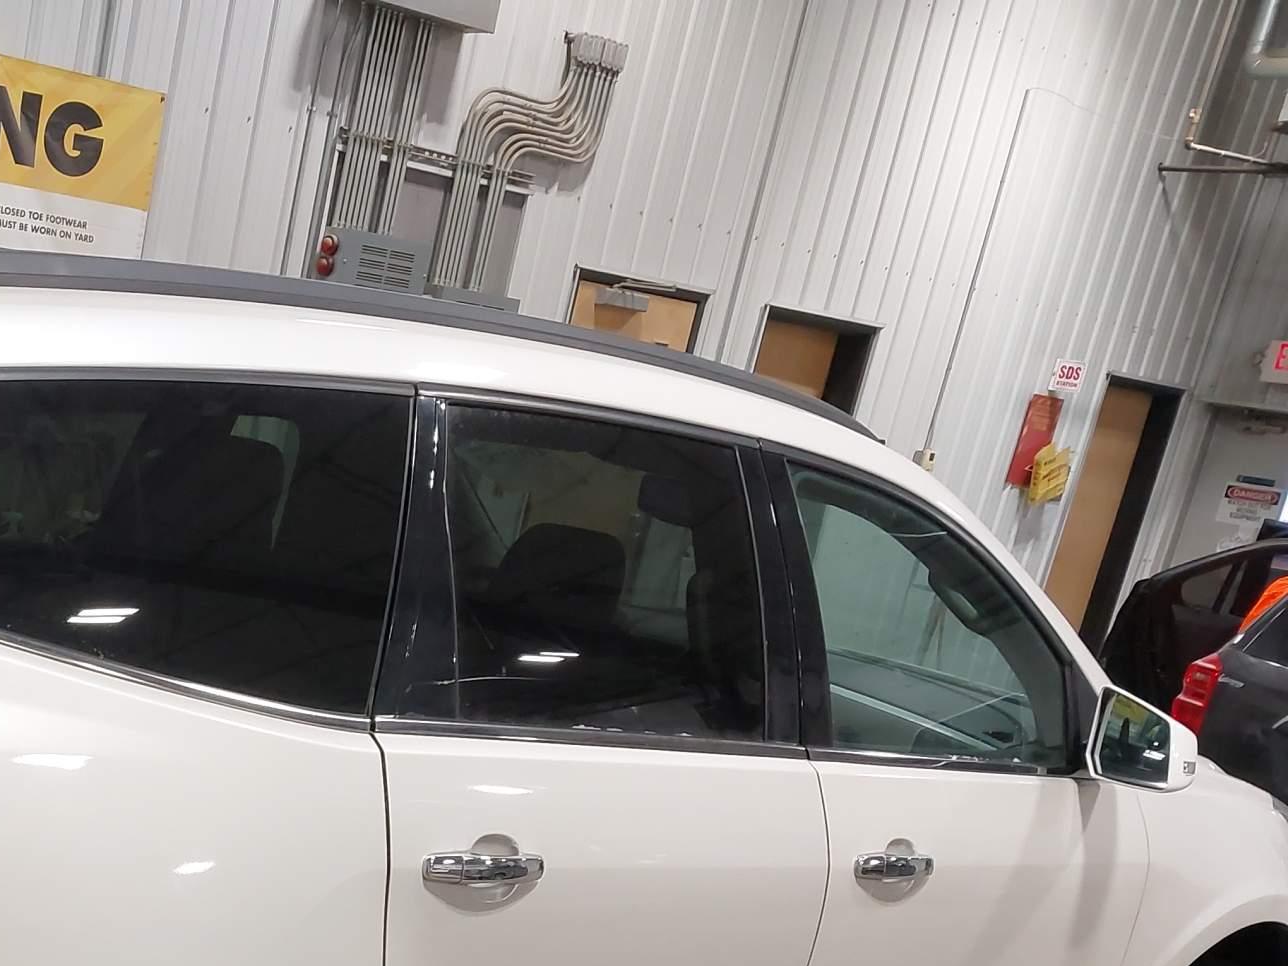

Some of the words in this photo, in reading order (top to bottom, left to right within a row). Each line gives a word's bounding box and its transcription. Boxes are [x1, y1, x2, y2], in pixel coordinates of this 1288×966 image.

[28, 211, 44, 221] TOE
[46, 214, 88, 230] FOOTWEAR
[19, 222, 29, 232] BE
[31, 225, 57, 237] WORN
[59, 230, 72, 239] ON
[74, 232, 94, 243] YARD
[1059, 365, 1082, 380] SDS
